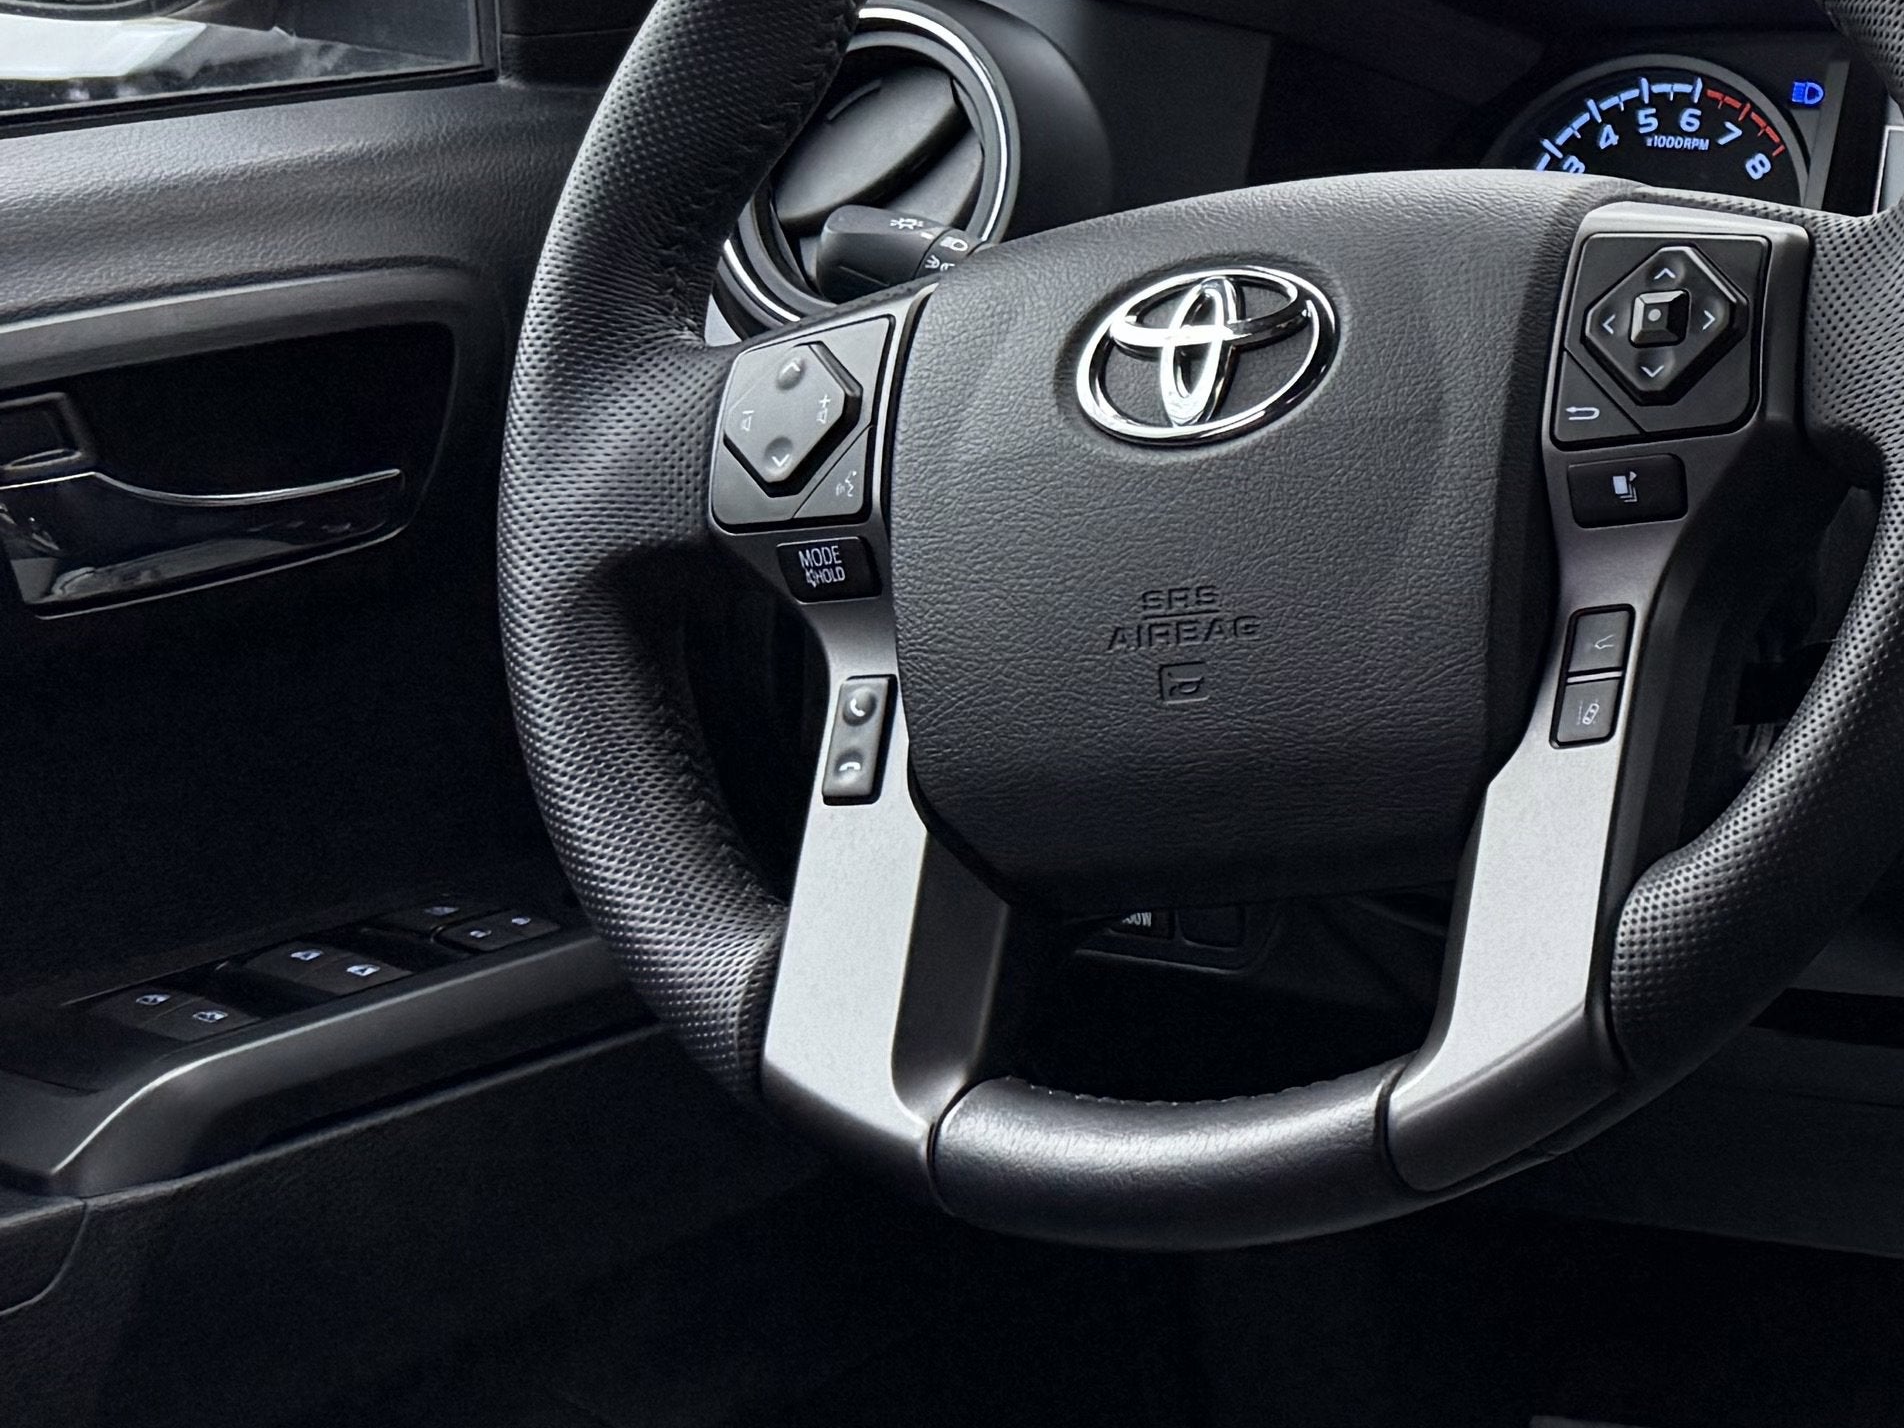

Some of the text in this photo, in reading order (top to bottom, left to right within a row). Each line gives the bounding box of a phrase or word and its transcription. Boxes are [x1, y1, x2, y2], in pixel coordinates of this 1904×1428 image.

[1636, 108, 1659, 133] 5
[1679, 108, 1702, 132] 6
[1599, 124, 1619, 149] 4
[1716, 121, 1743, 146] 7
[1745, 153, 1772, 180] 8
[799, 545, 842, 568] MODE
[1106, 616, 1261, 652] AIRBAG
